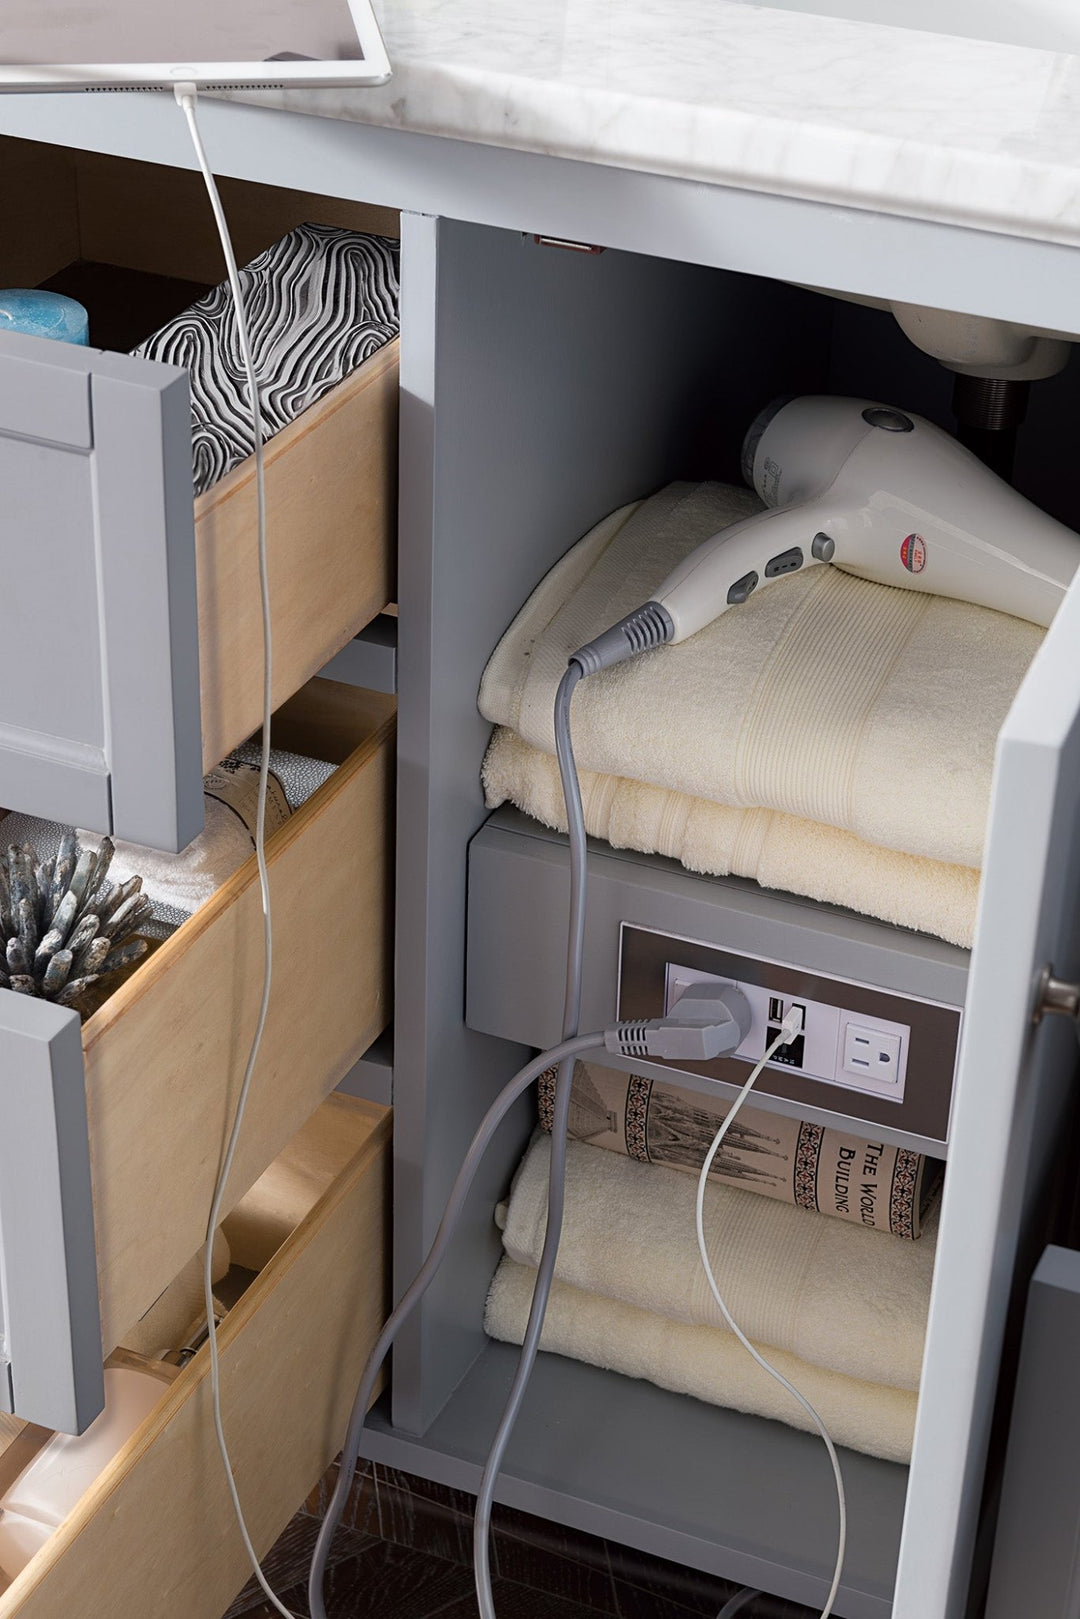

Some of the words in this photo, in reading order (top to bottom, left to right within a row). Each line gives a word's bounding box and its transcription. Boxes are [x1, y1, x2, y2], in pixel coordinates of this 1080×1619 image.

[835, 1147, 856, 1213] BUILDING
[863, 1144, 884, 1176] THE
[860, 1184, 877, 1226] WORLD
